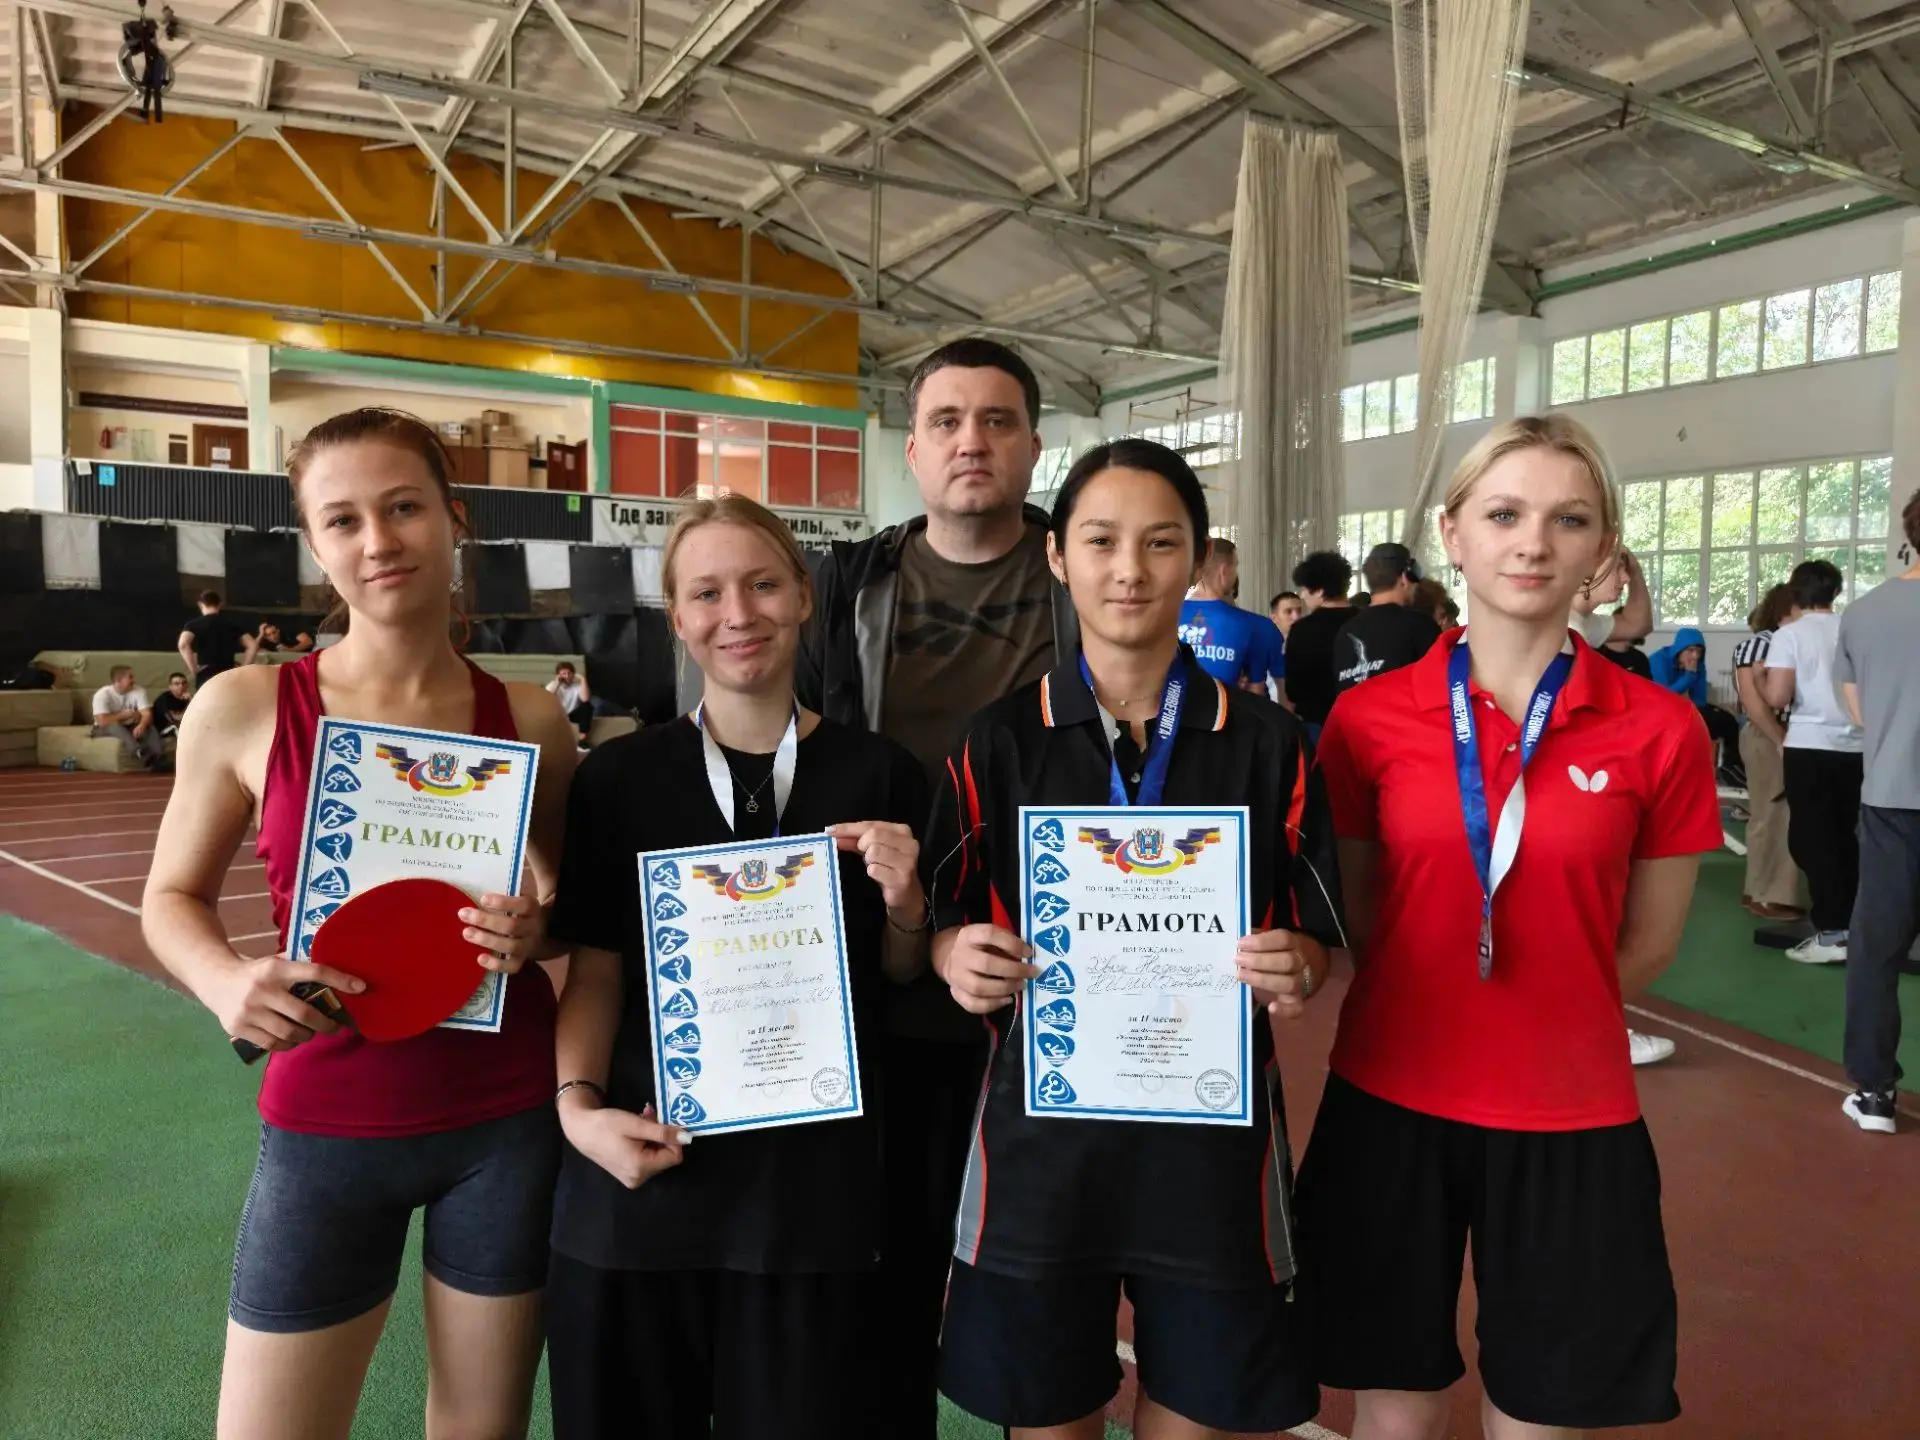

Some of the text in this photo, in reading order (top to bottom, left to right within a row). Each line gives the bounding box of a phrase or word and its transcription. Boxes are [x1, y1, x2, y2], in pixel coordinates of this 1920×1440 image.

[611, 503, 641, 526] Где
[361, 822, 503, 856] ГРАМОТА
[1077, 912, 1226, 934] ГРАМОТА
[697, 927, 824, 958] ГРАМОТА
